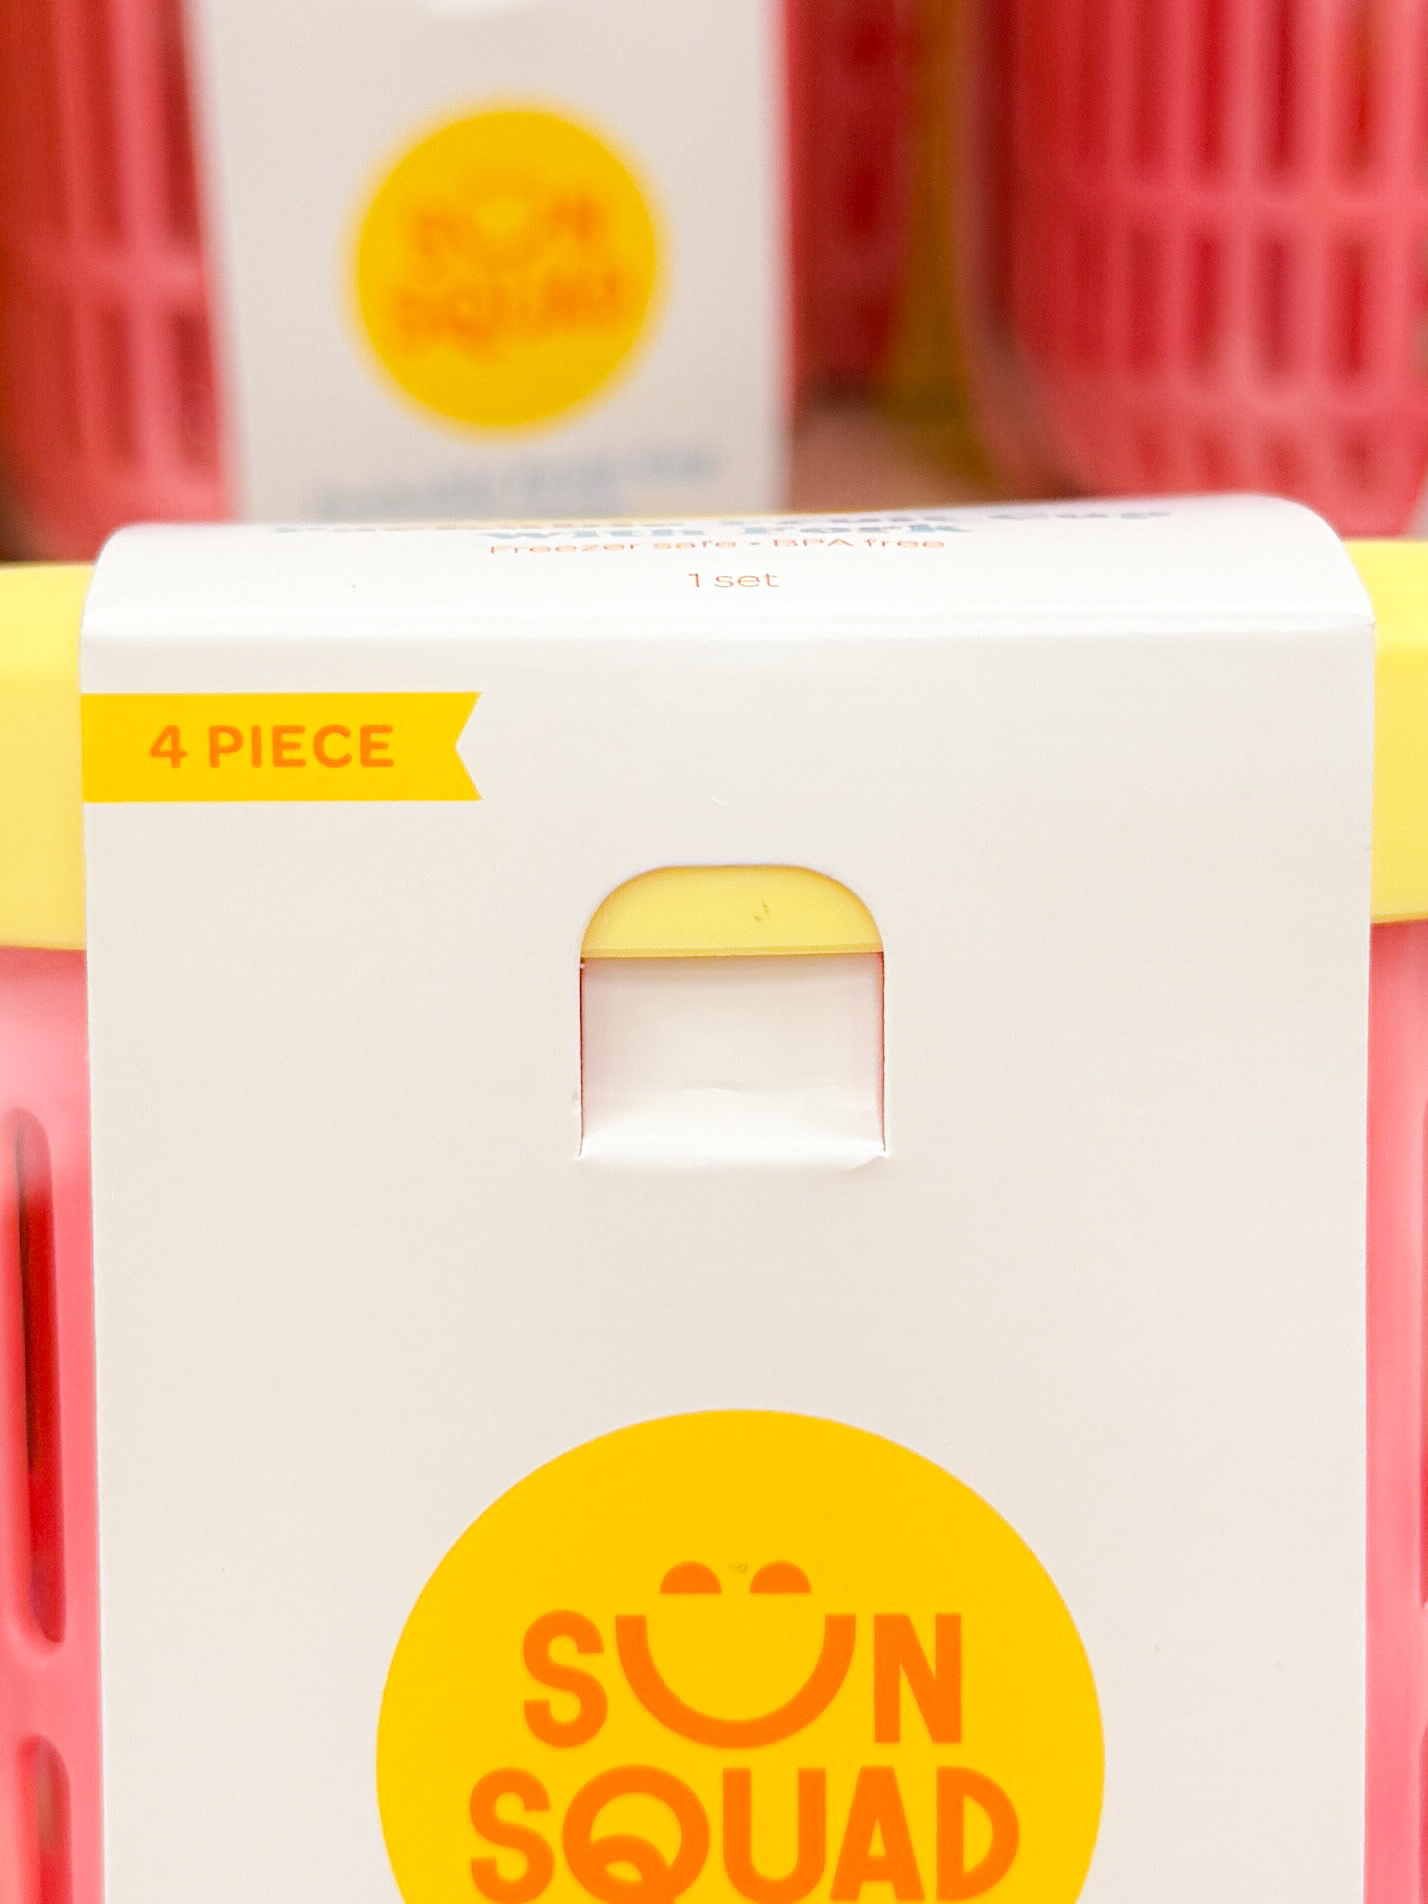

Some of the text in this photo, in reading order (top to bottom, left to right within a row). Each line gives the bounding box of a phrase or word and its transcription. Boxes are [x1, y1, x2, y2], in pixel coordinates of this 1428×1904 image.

[687, 571, 779, 589] 1 set
[149, 723, 395, 770] 4 PIECE
[523, 1559, 963, 1750] SUN
